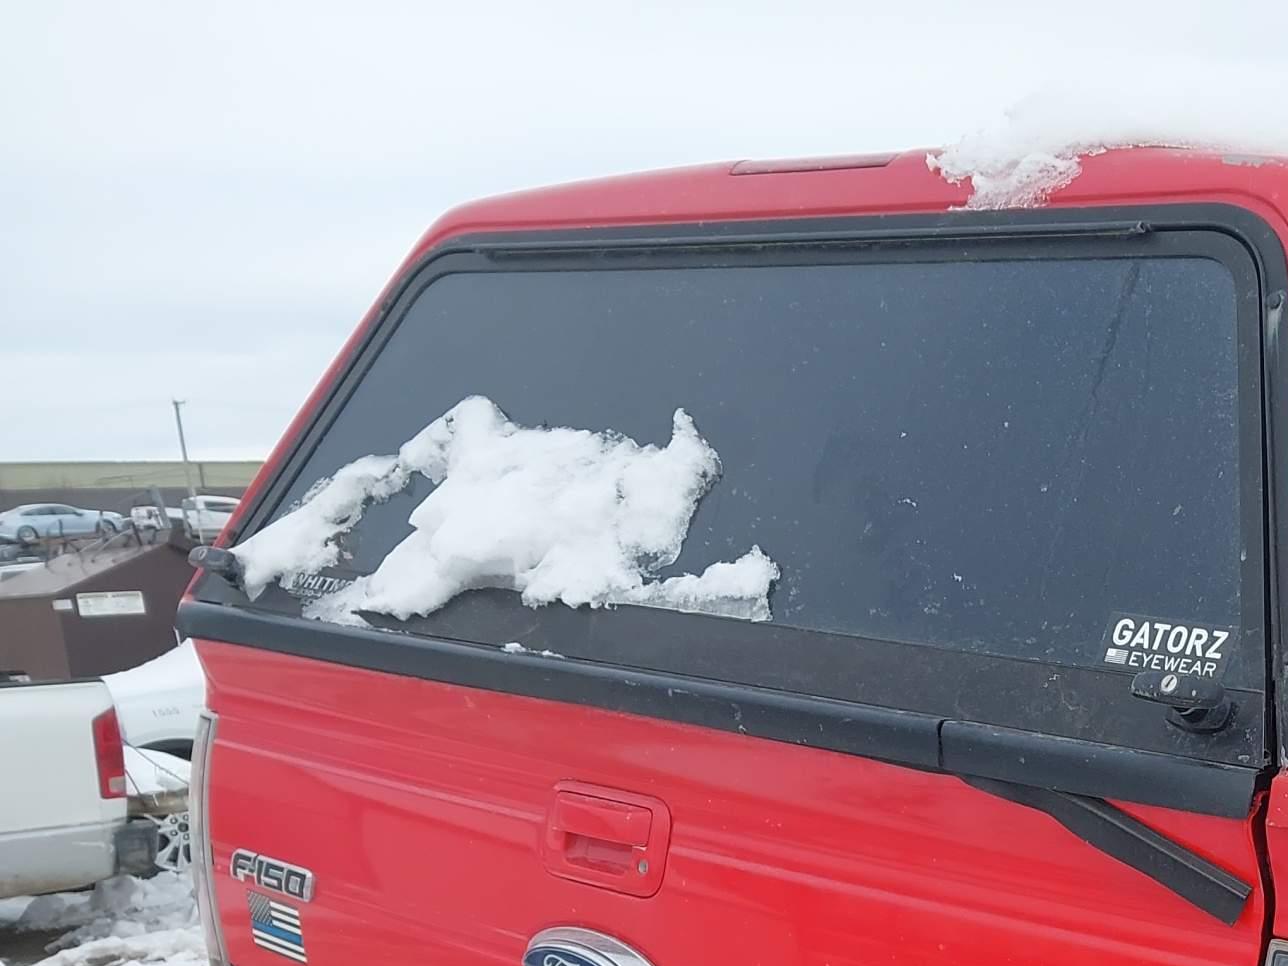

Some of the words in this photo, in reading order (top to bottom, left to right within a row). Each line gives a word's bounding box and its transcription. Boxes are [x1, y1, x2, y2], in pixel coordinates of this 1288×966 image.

[1112, 618, 1229, 660] GATORZ
[1128, 651, 1217, 678] EYEWEAR
[231, 849, 313, 902] F-150
